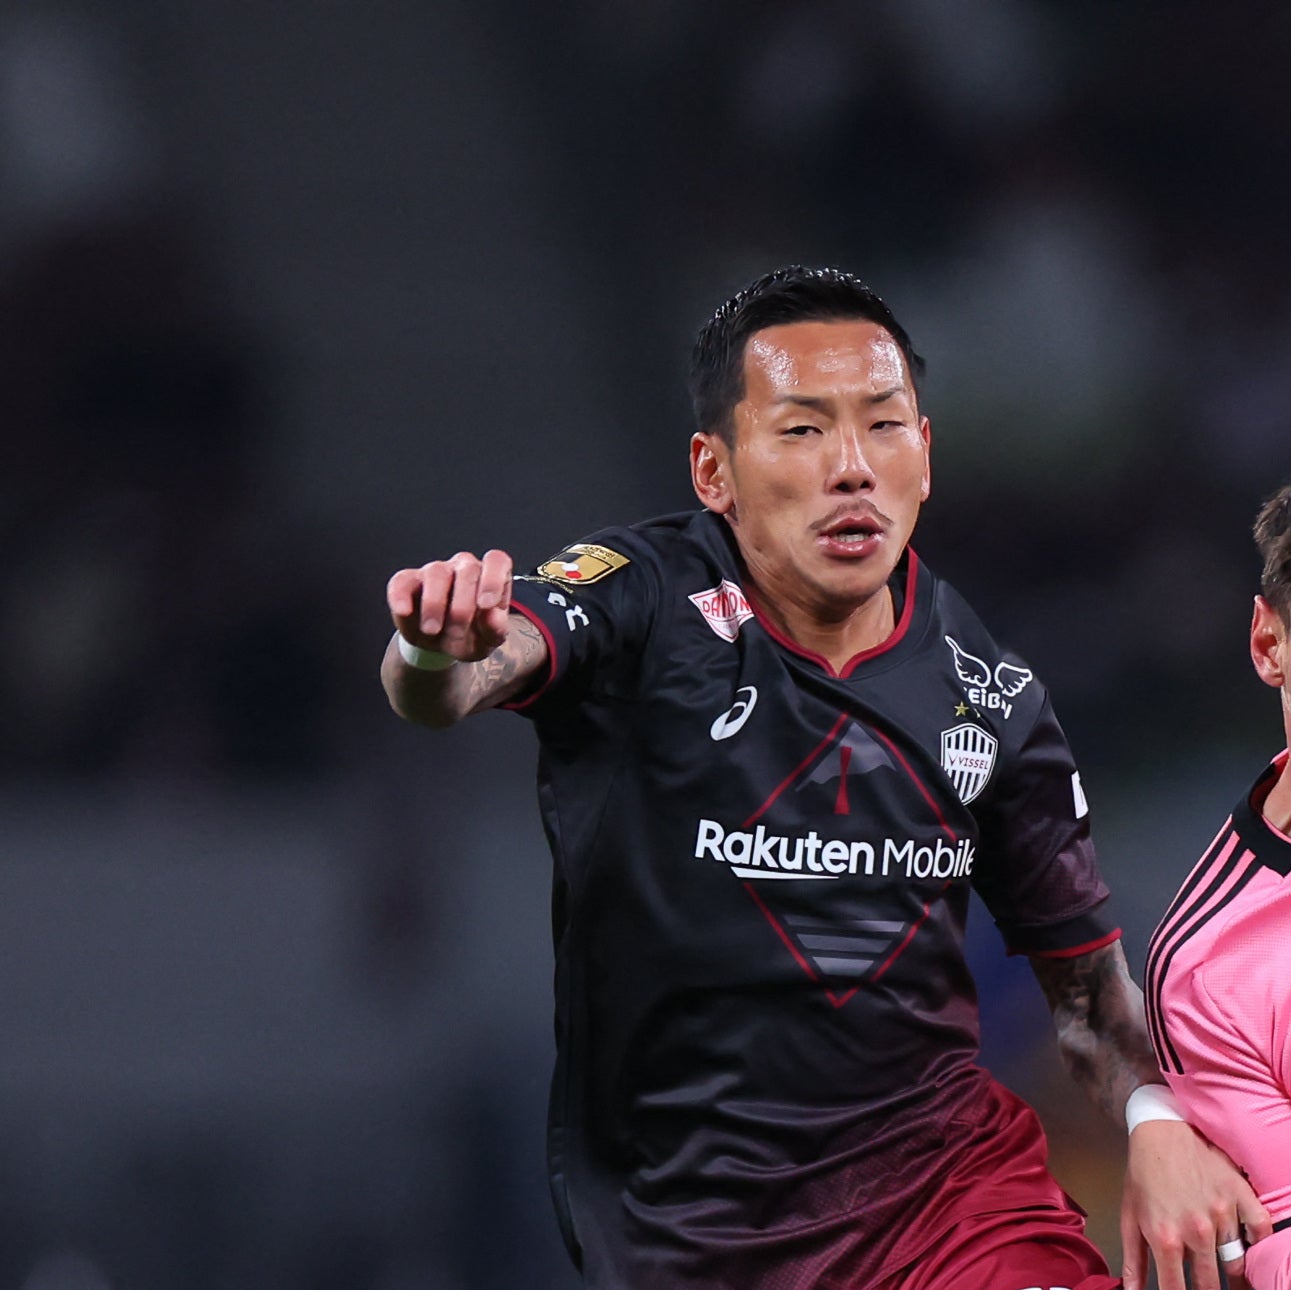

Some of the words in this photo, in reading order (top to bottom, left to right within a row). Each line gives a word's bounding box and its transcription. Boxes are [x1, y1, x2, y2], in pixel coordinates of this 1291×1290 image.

[958, 756, 989, 770] VISSEL
[695, 819, 875, 876] Rakuten
[881, 838, 976, 878] Mobile
